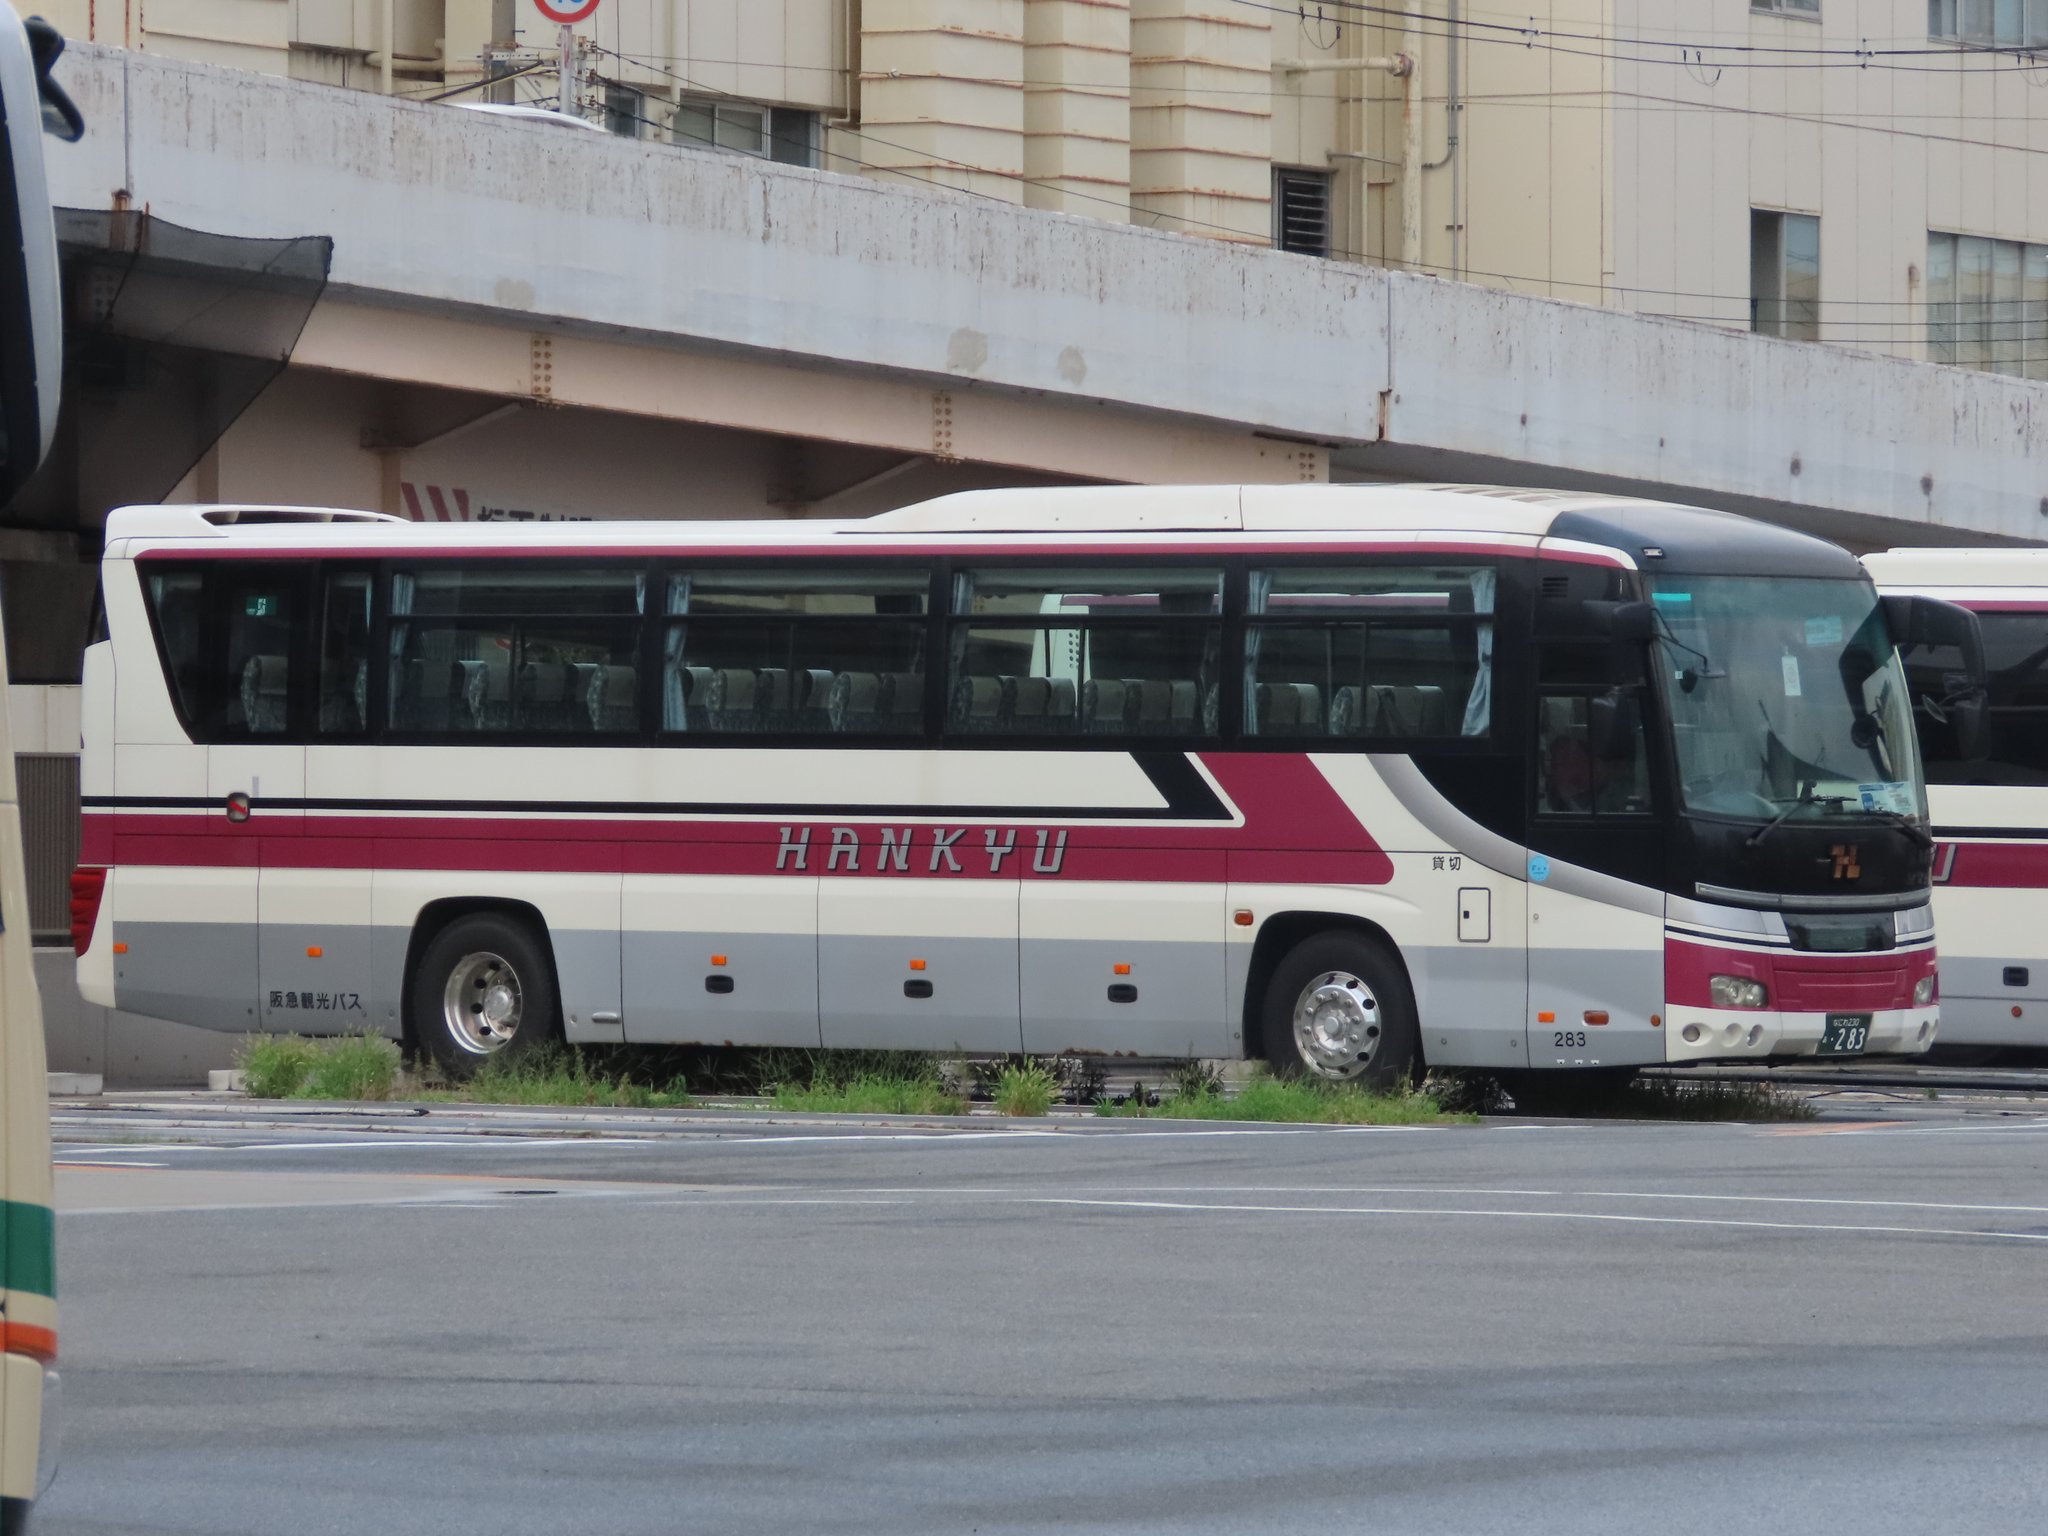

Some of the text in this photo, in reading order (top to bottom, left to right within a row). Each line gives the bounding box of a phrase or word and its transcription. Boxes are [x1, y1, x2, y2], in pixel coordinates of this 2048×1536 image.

[775, 826, 1068, 874] HANKYU
[1431, 856, 1461, 871] 貸切
[269, 990, 362, 1010] 阪急観光バス
[1554, 1031, 1586, 1047] 283
